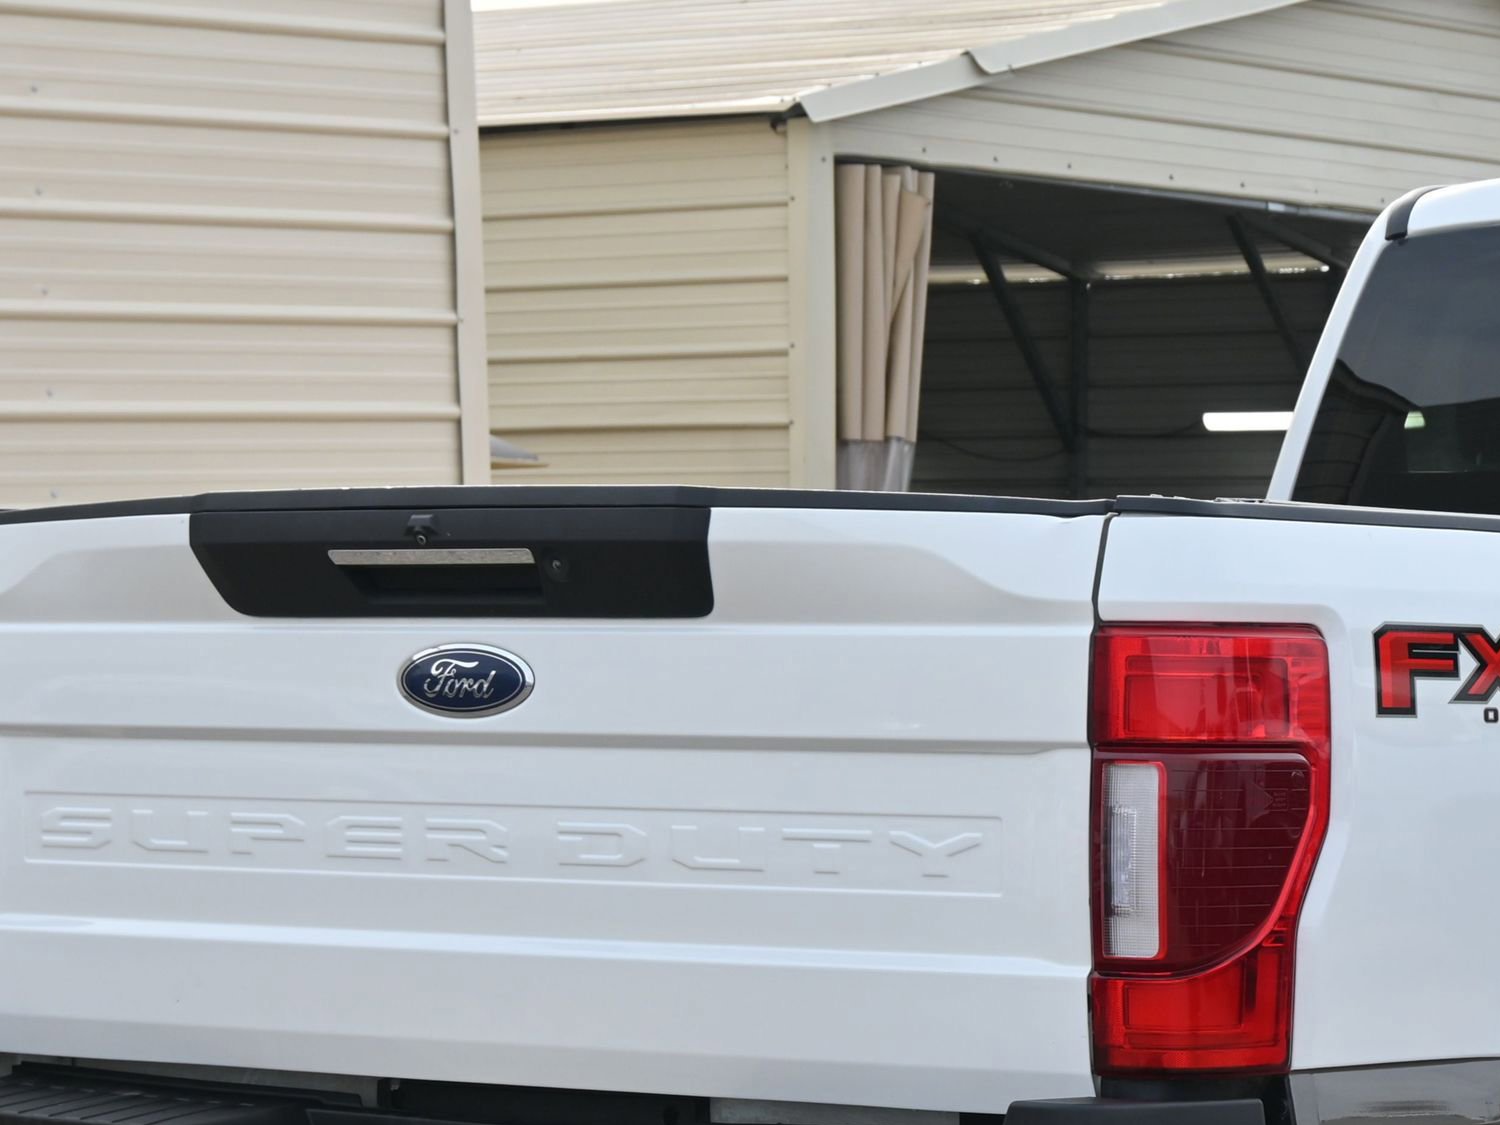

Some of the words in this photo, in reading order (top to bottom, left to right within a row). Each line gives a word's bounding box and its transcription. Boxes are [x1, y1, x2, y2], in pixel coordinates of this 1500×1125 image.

[424, 658, 497, 698] Ford
[40, 807, 508, 864] SUPER
[557, 821, 984, 878] DUTY
